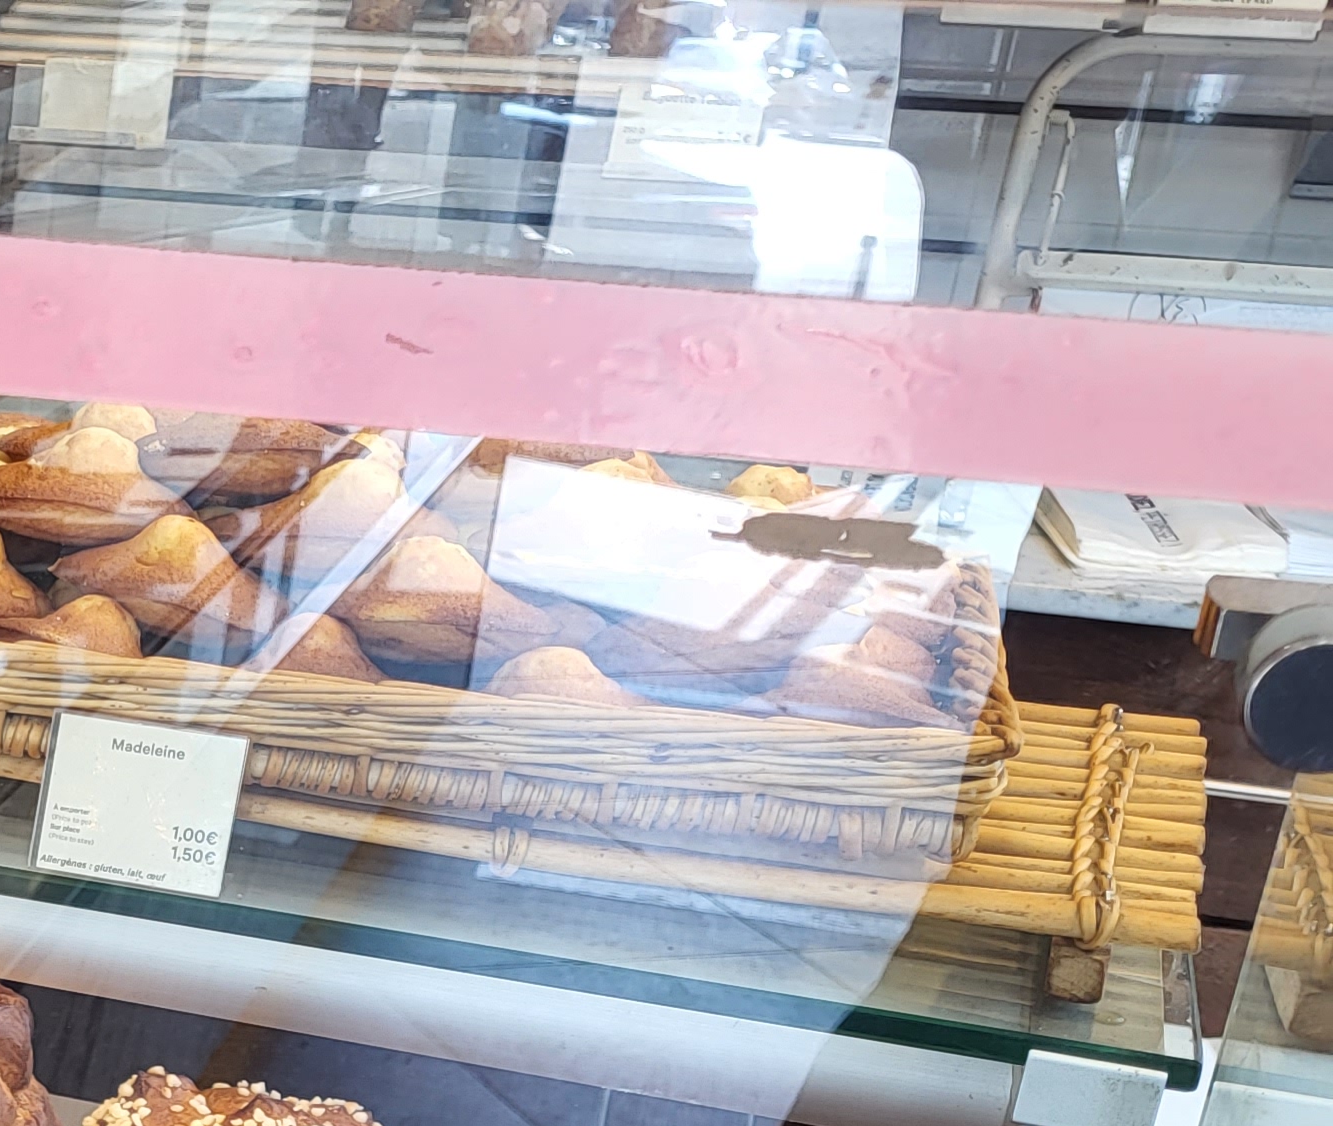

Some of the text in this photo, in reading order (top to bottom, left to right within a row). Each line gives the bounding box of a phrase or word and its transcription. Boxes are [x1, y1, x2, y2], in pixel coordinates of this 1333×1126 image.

[111, 738, 185, 760] Madeleine
[172, 826, 219, 846] 1,00€
[40, 854, 86, 870] Allergènes
[94, 863, 125, 876] gluten,
[171, 846, 216, 865] 1,50€
